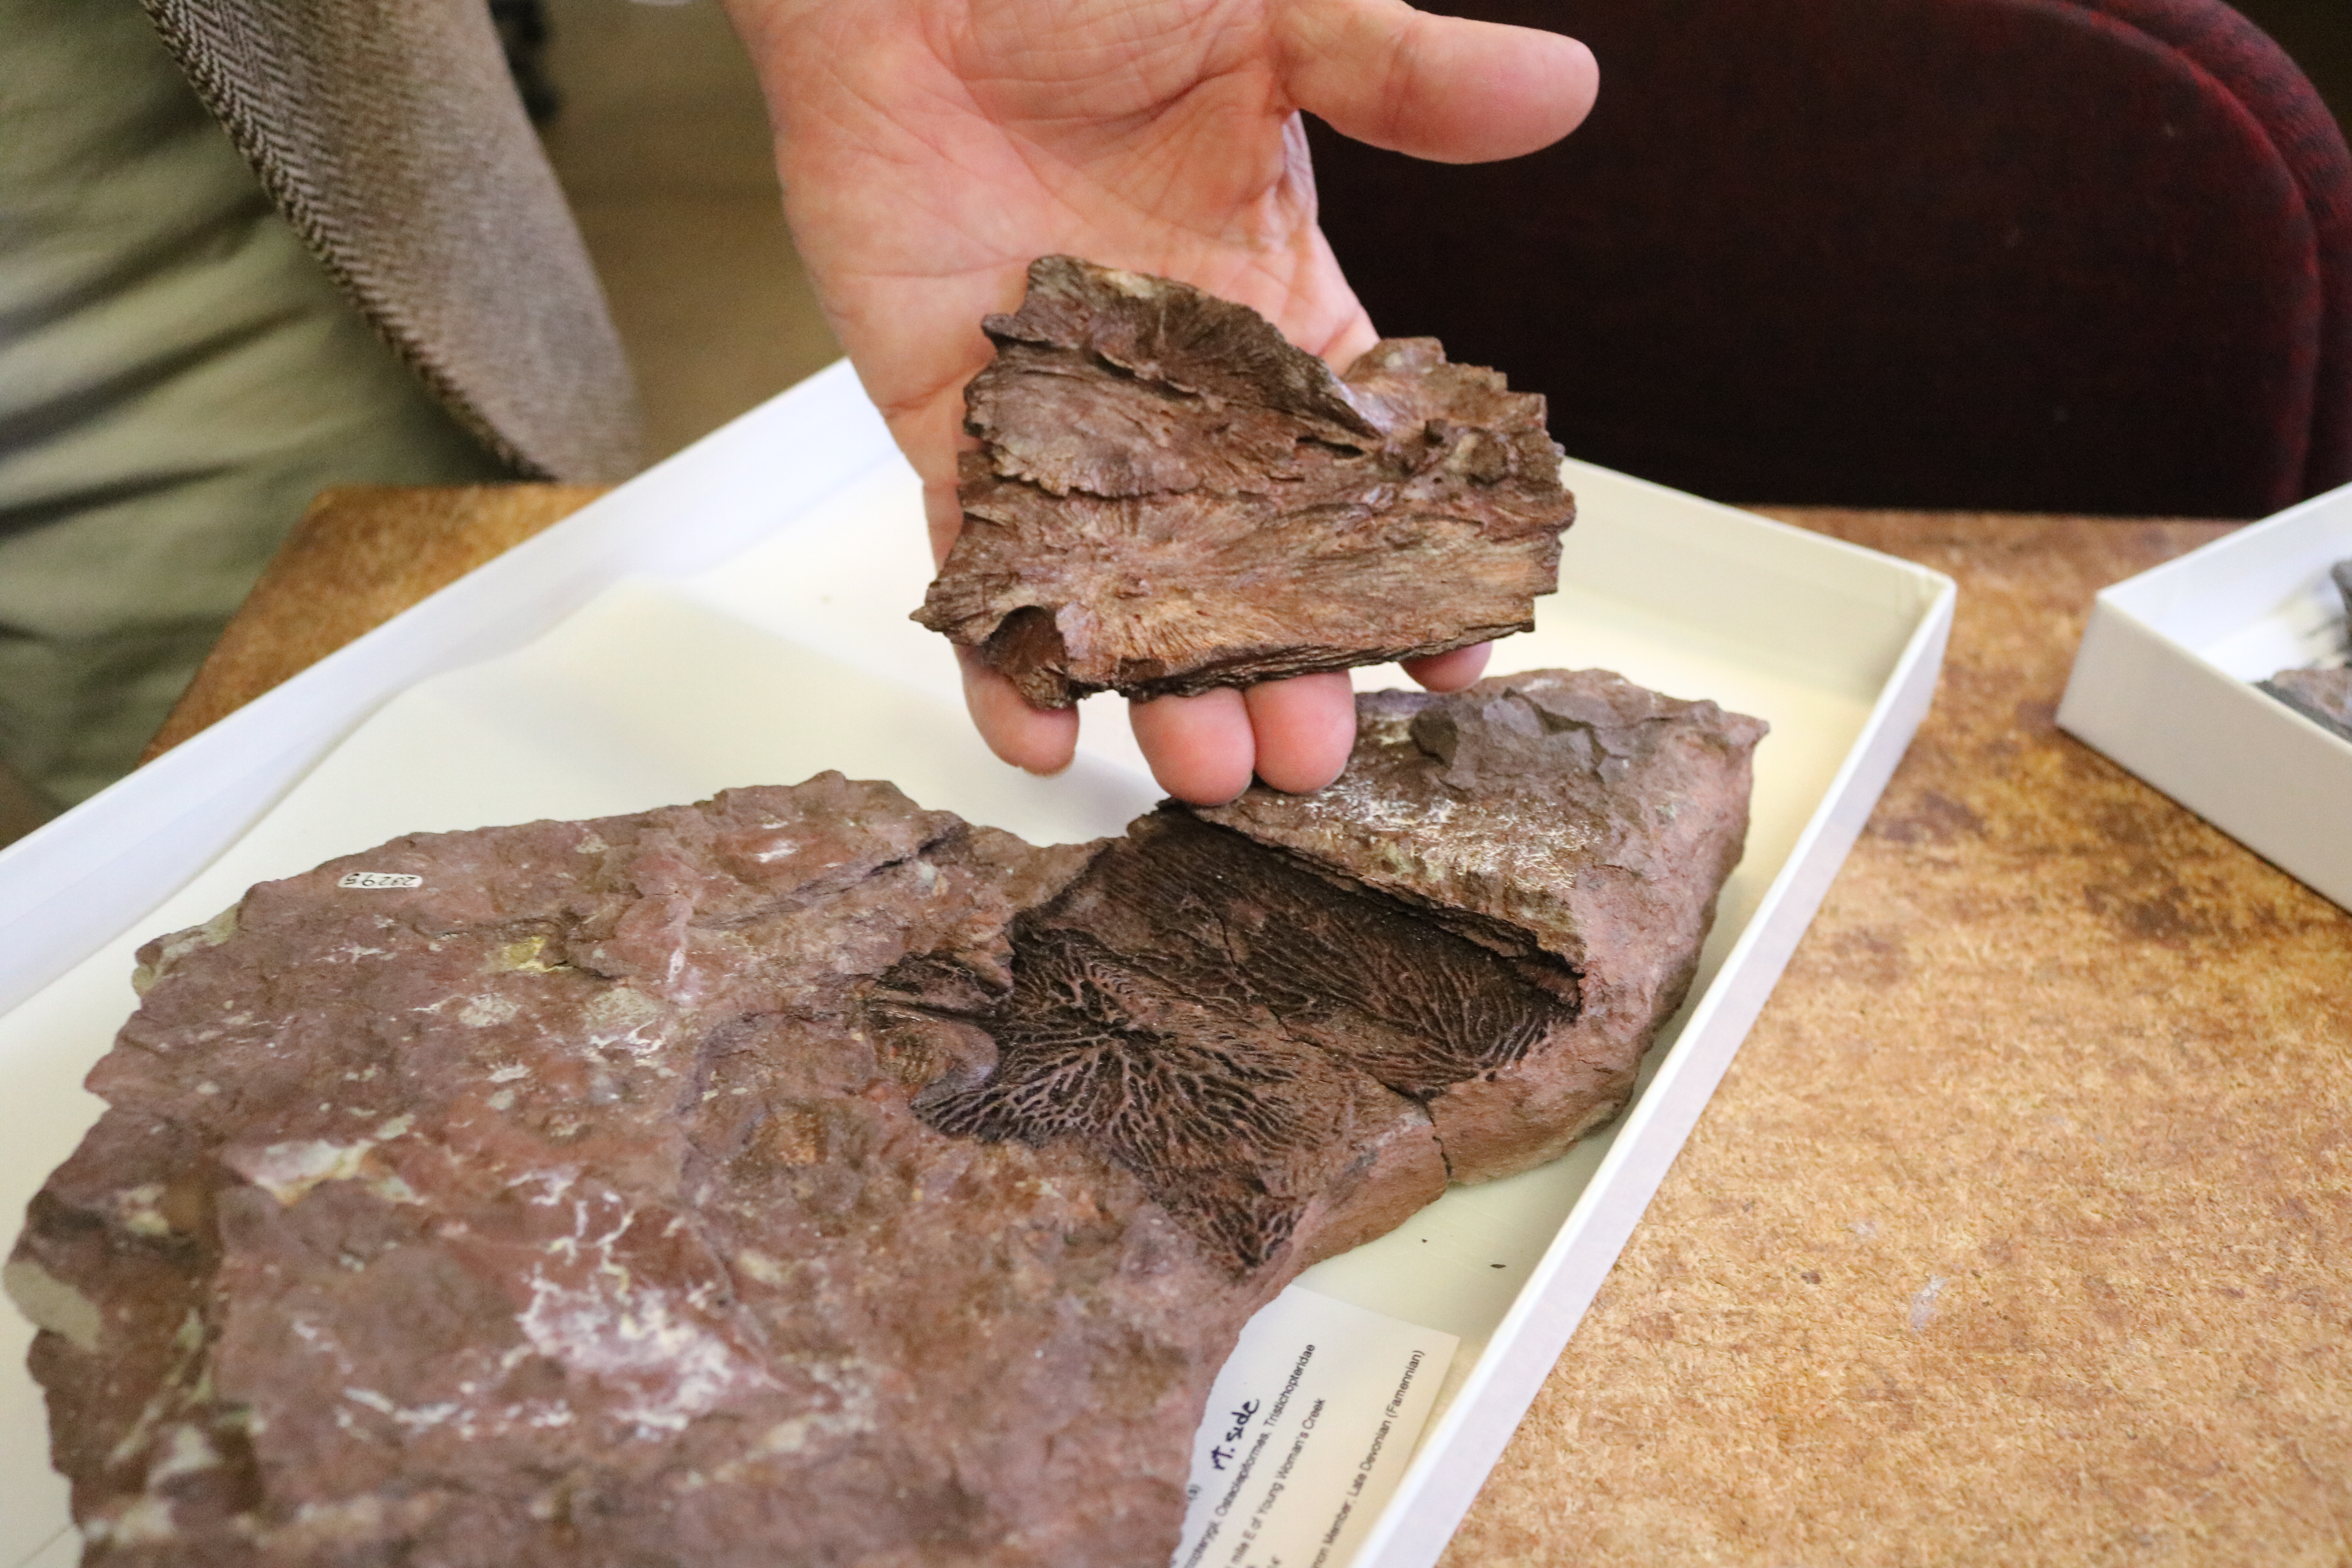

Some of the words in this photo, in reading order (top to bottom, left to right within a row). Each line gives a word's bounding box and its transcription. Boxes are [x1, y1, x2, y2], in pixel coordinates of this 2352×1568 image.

[1225, 1399, 1260, 1442] side
[1263, 1344, 1315, 1426] Tristichopteridae
[1347, 1472, 1368, 1497] Late
[1359, 1419, 1392, 1472] Devonian
[1386, 1350, 1426, 1418] (Famennian)
[1256, 1482, 1285, 1515] Young
[1275, 1432, 1309, 1479] Woman's
[1302, 1398, 1326, 1430] Creek
